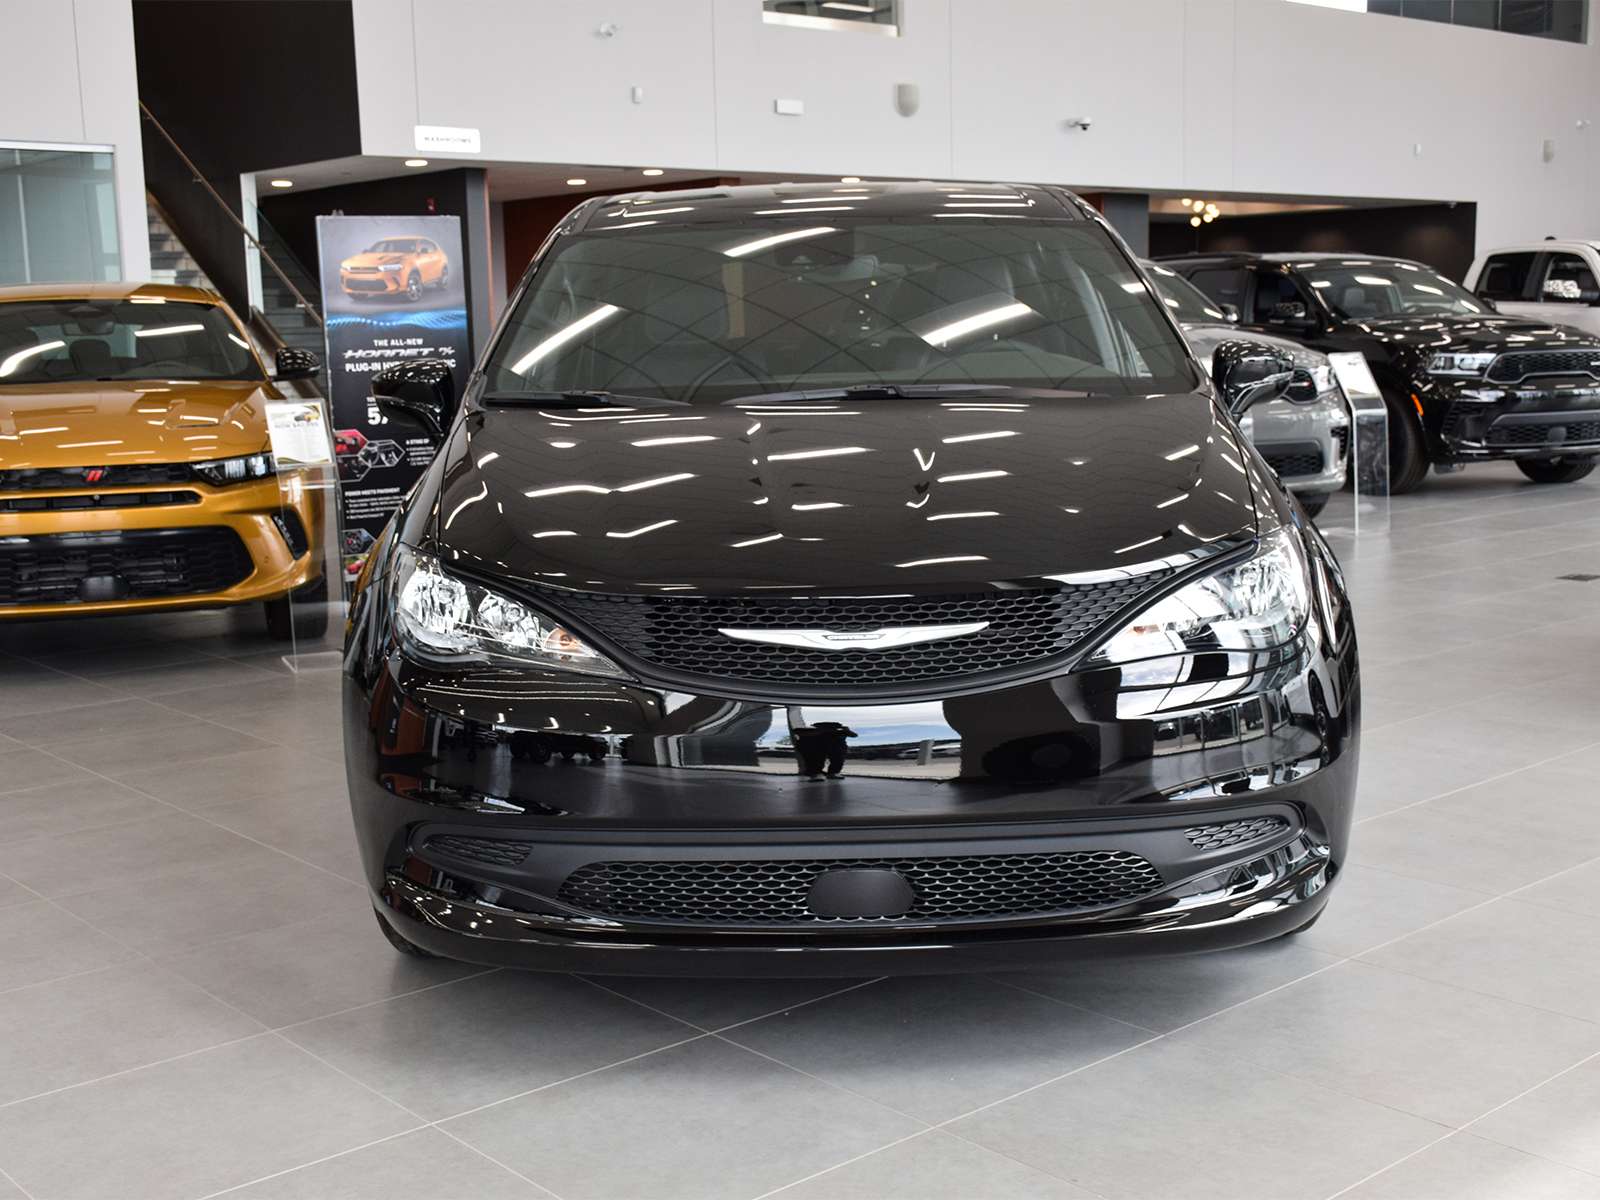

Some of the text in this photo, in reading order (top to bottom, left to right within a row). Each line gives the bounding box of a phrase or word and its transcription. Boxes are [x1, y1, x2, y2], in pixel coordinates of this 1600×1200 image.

[390, 338, 423, 346] ALL-NEW
[343, 348, 434, 359] HORNET
[345, 362, 381, 372] PLUG-IN
